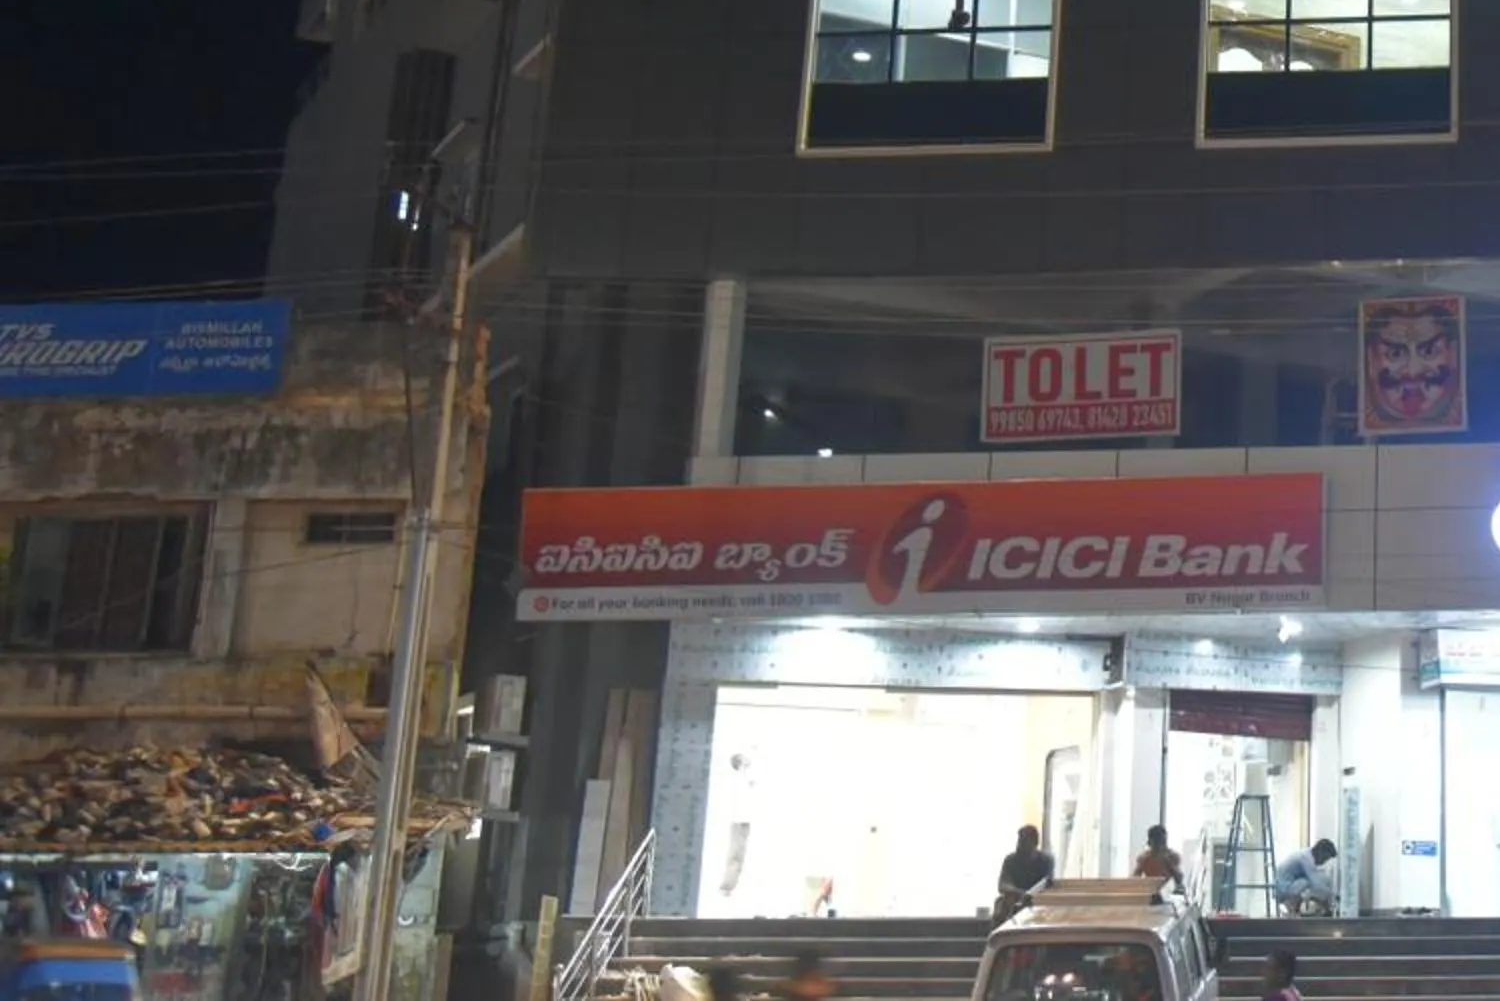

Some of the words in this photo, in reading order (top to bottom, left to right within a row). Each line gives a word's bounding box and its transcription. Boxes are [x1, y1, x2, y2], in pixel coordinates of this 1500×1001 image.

[993, 348, 1063, 404] TO
[1073, 343, 1173, 401] LET
[535, 535, 704, 573] ఐసిఐసిఐ
[715, 528, 856, 581] బ్యాంక్
[968, 536, 1126, 581] ICICI
[1138, 531, 1307, 577] Bank
